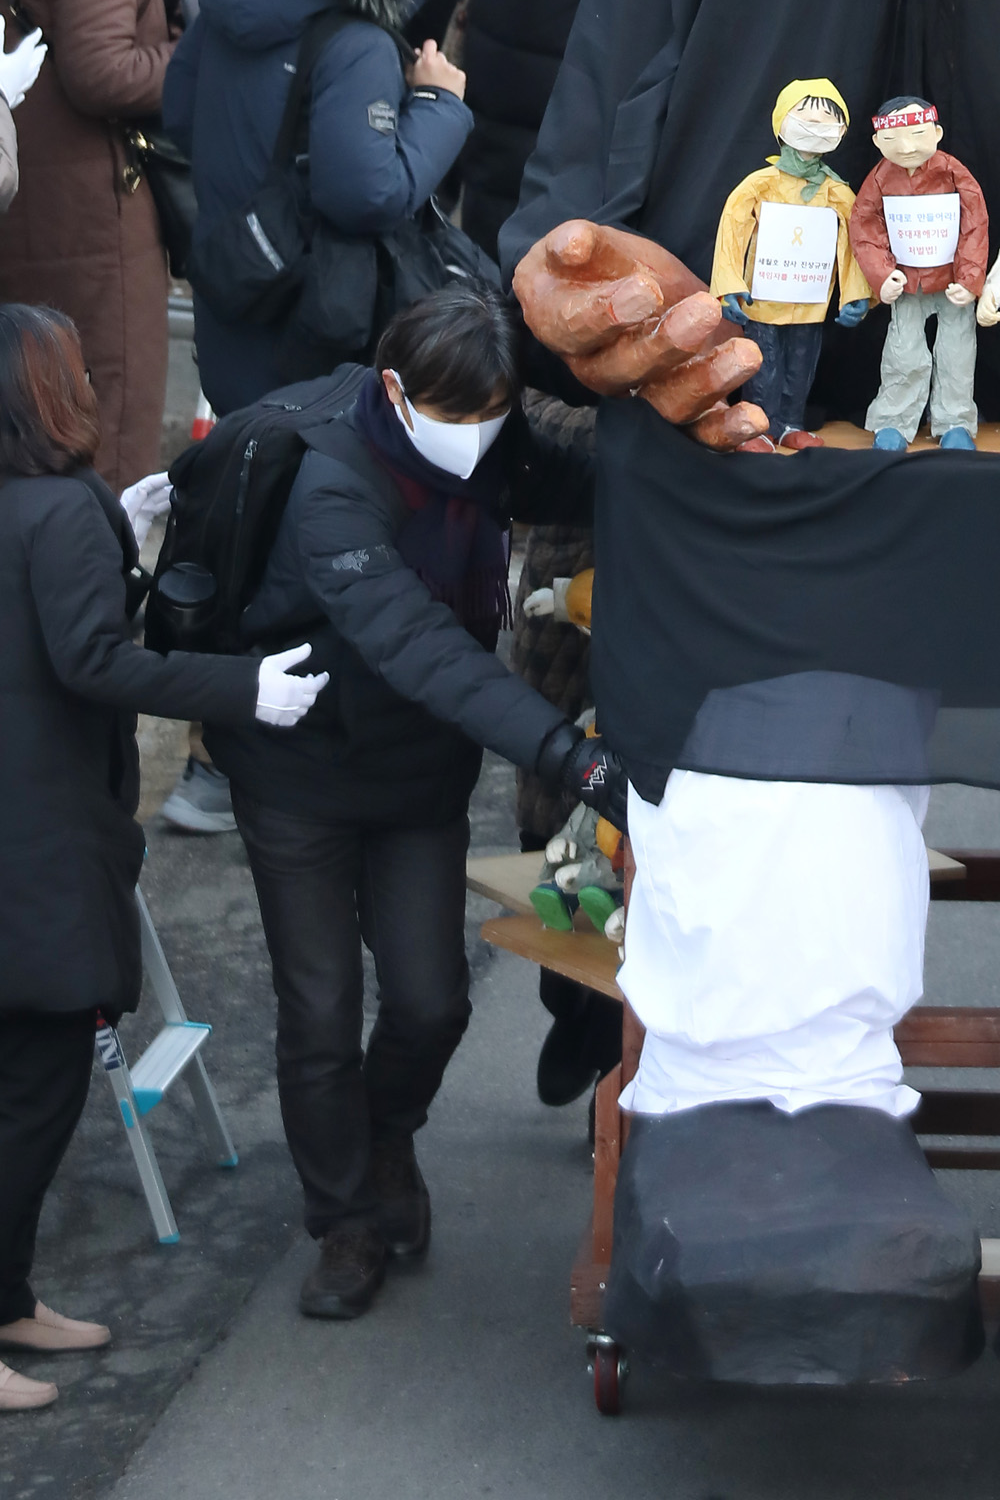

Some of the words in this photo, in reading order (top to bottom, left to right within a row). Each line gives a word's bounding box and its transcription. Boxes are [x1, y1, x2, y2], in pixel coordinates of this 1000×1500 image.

[873, 113, 908, 129] 비정규직
[897, 228, 948, 239] 중대재해기업
[908, 245, 938, 256] 처벌법!
[758, 258, 779, 267] 세월호
[783, 260, 797, 268] 참사
[801, 261, 831, 270] 진상규명!
[793, 273, 827, 283] 처벌하라!
